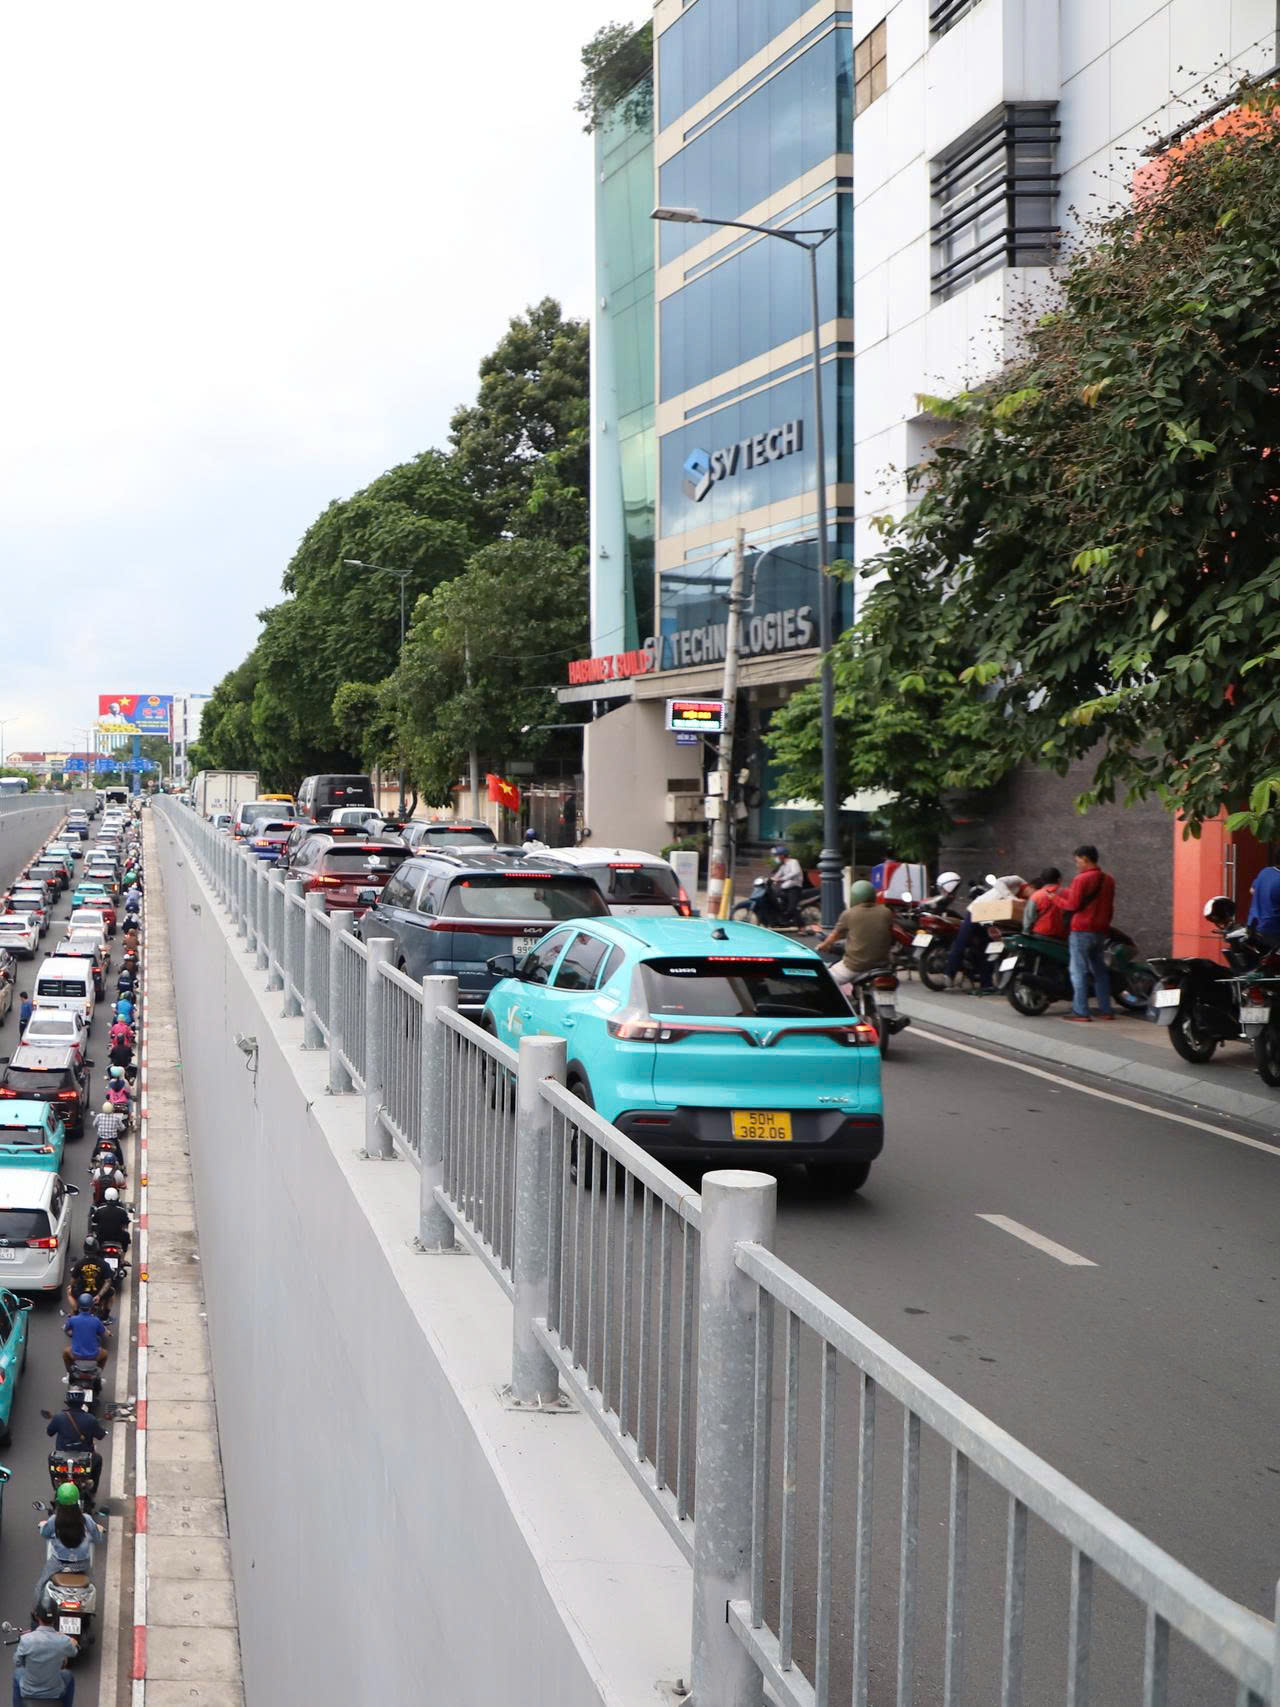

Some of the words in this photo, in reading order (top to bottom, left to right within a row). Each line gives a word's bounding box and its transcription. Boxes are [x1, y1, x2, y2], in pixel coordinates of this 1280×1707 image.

[671, 605, 813, 666] TECHNLOGIES
[749, 1112, 776, 1125] 50H
[740, 1126, 786, 1139] 382.06
